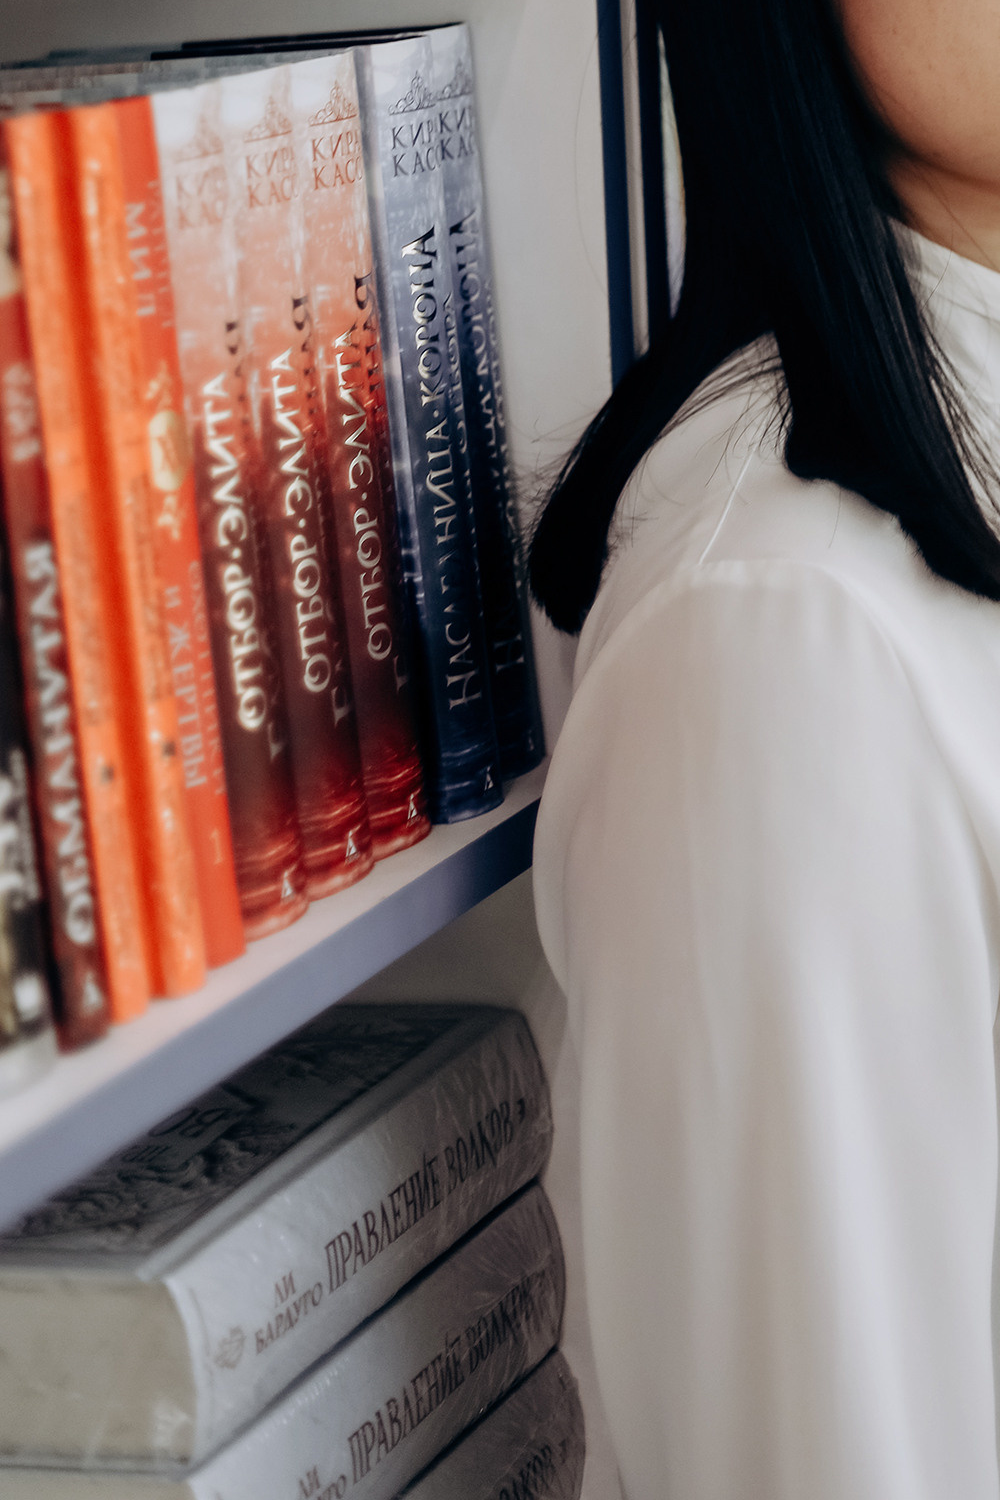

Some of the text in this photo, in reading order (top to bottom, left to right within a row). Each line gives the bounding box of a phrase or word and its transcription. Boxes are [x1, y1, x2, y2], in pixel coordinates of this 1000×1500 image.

[24, 539, 96, 944] ОБМАНУТАЯ
[323, 1153, 442, 1296] ПРАВЛЕНИЕ
[347, 1330, 465, 1486] ПРАВЛЕНИЕ
